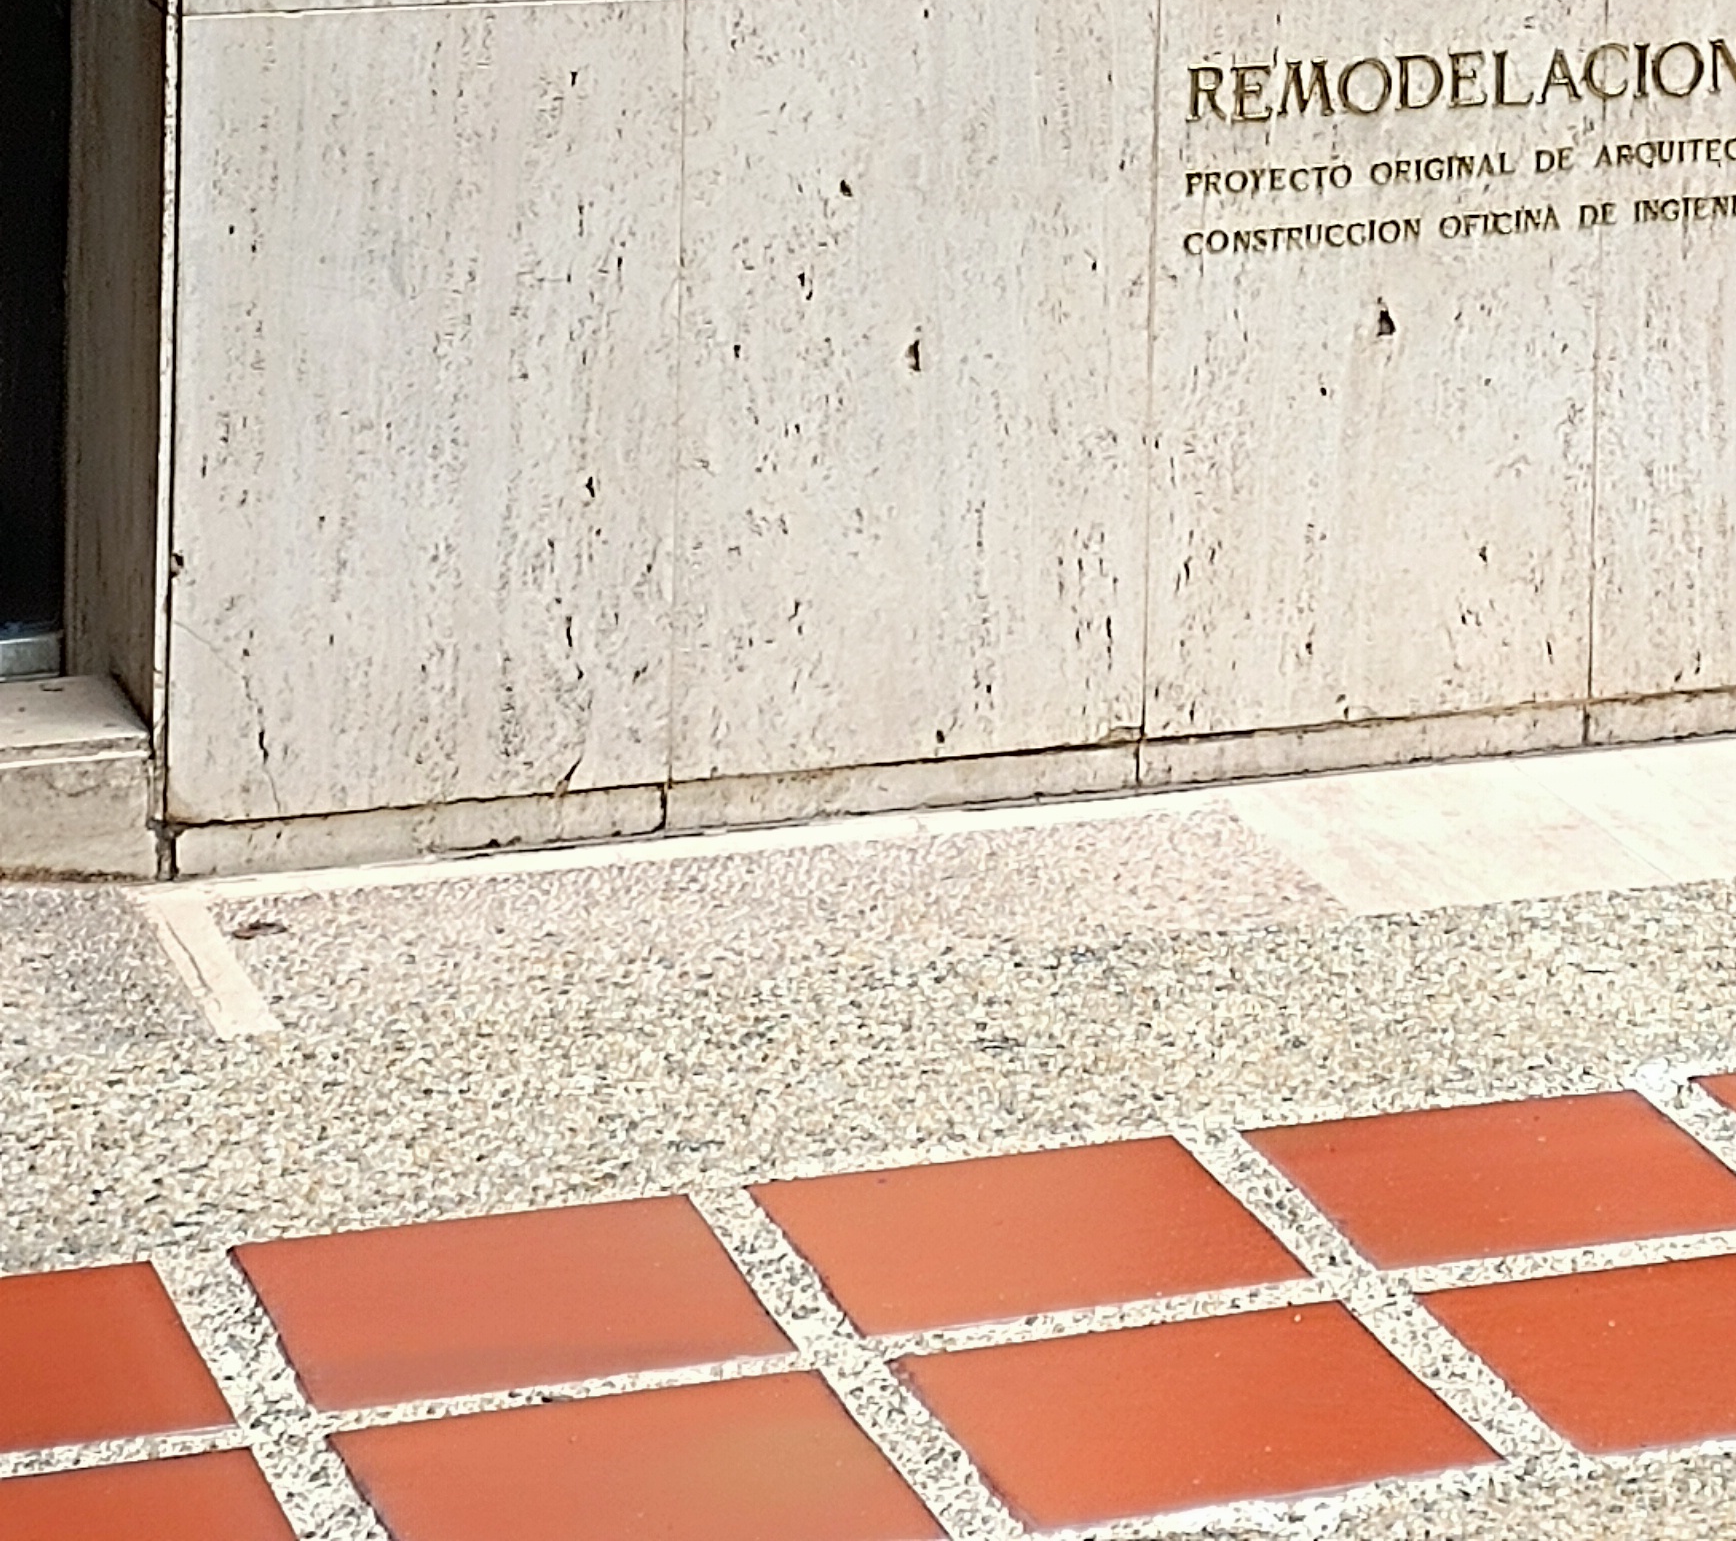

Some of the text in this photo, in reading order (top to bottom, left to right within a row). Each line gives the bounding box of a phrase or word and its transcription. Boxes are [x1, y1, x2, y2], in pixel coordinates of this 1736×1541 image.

[1184, 162, 1352, 198] PROYECTO
[1370, 151, 1517, 186] ORIGINAL
[1535, 146, 1574, 174] DE
[1183, 215, 1421, 256] CONSTRUCCION
[1439, 205, 1559, 238] OFICINA
[1579, 202, 1616, 229] DE
